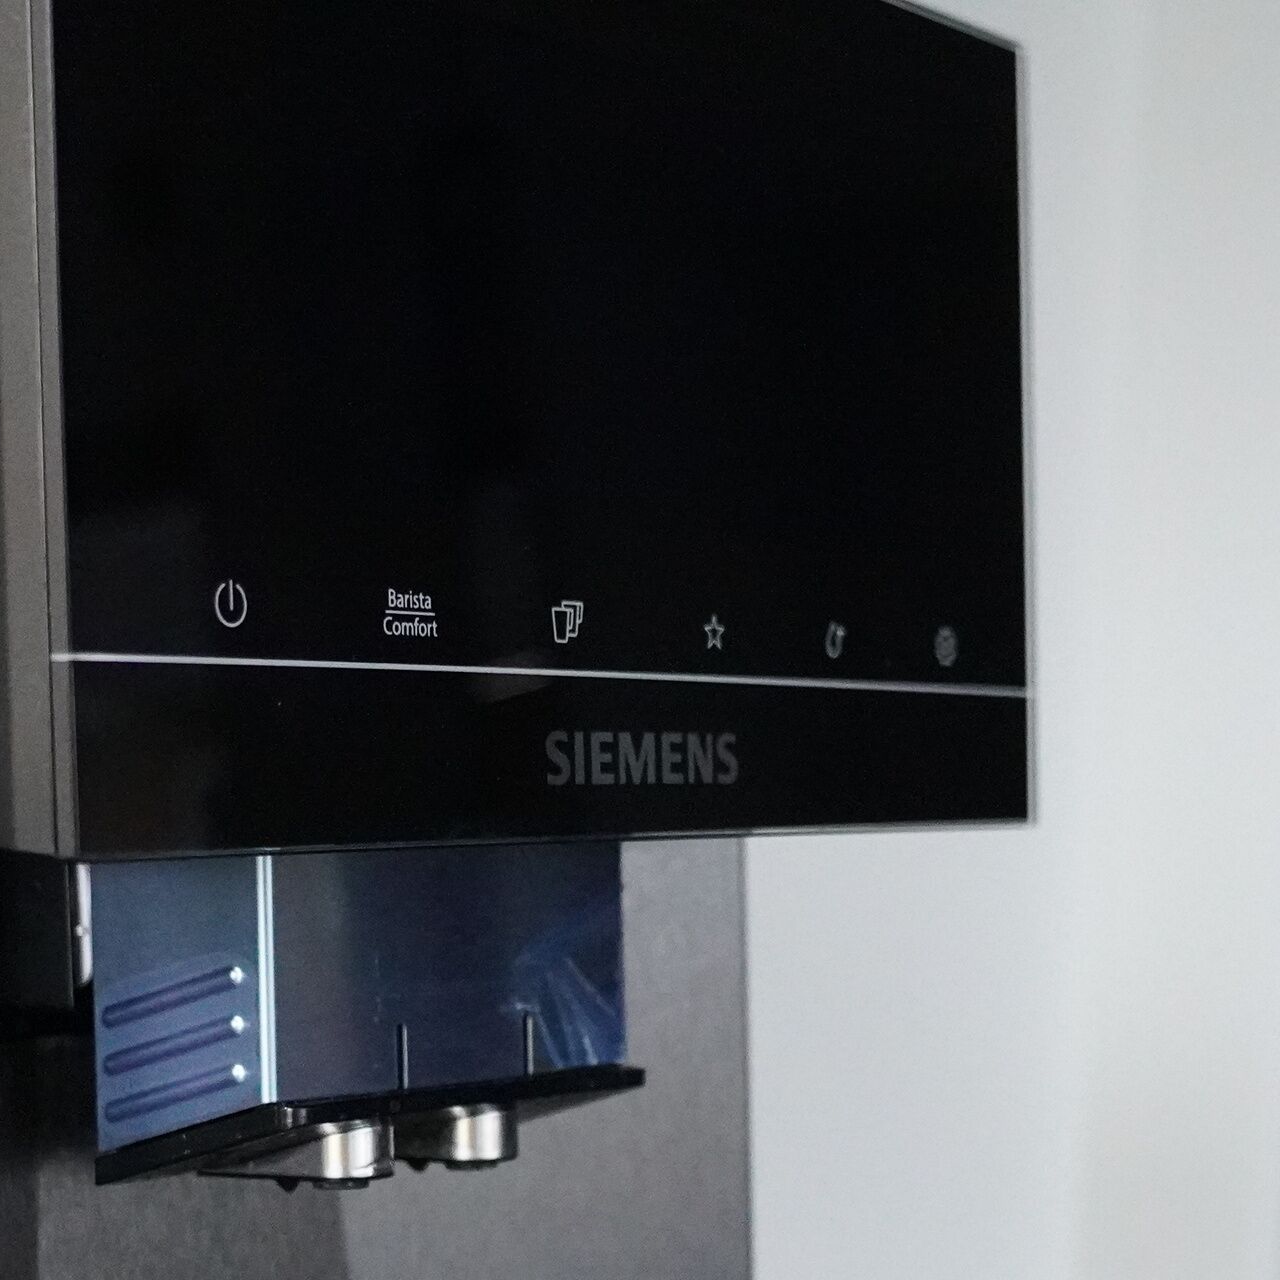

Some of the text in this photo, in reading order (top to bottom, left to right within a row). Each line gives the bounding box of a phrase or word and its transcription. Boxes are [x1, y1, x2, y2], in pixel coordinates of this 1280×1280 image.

[387, 588, 432, 611] Barista
[383, 616, 438, 638] Comfort
[546, 730, 739, 786] SIEMENS
